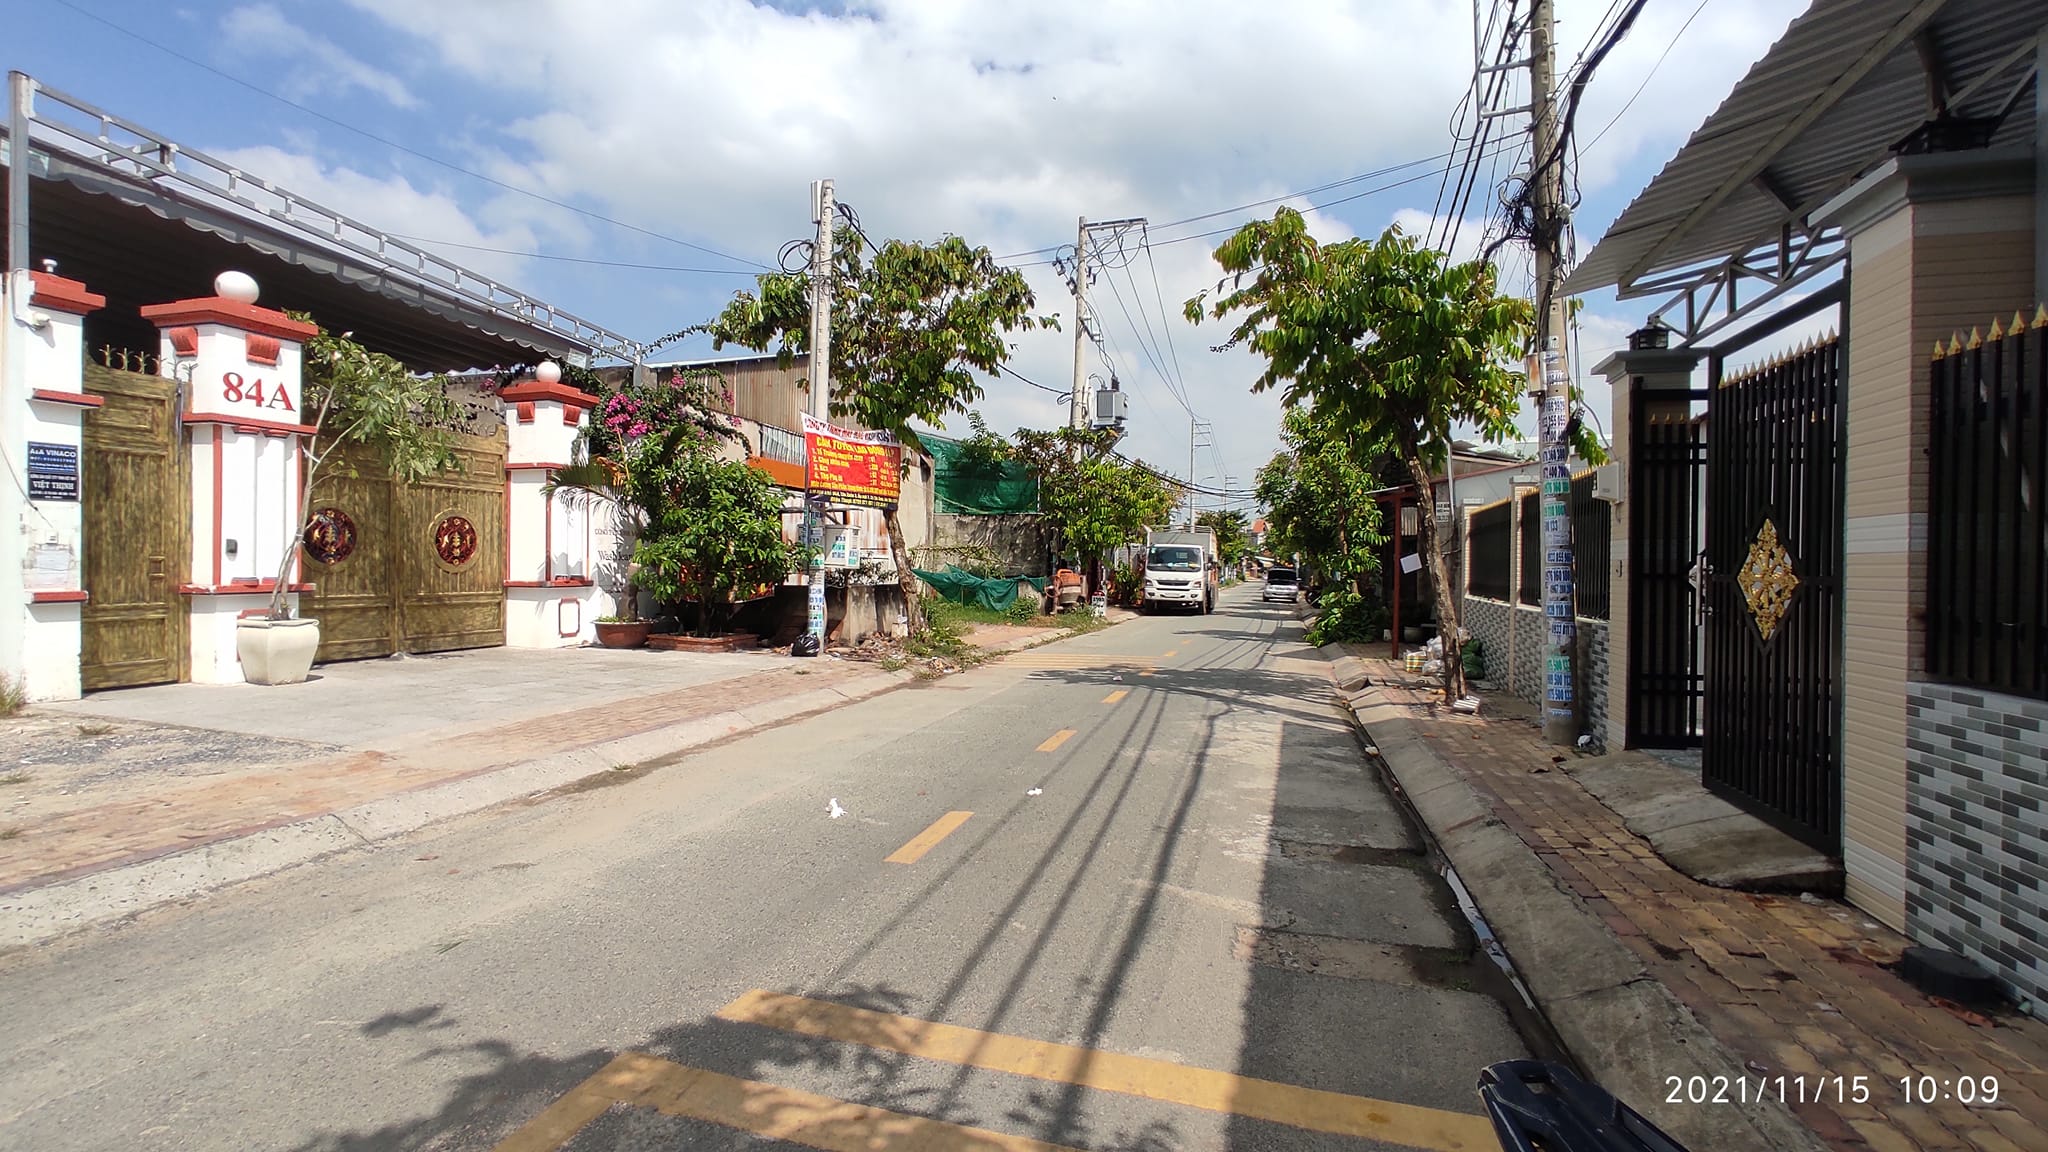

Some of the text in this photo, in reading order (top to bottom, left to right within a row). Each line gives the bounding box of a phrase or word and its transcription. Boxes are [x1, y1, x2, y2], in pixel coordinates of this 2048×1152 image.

[223, 372, 296, 412] 84A
[45, 449, 77, 458] VINACO
[32, 479, 50, 490] VIỆT
